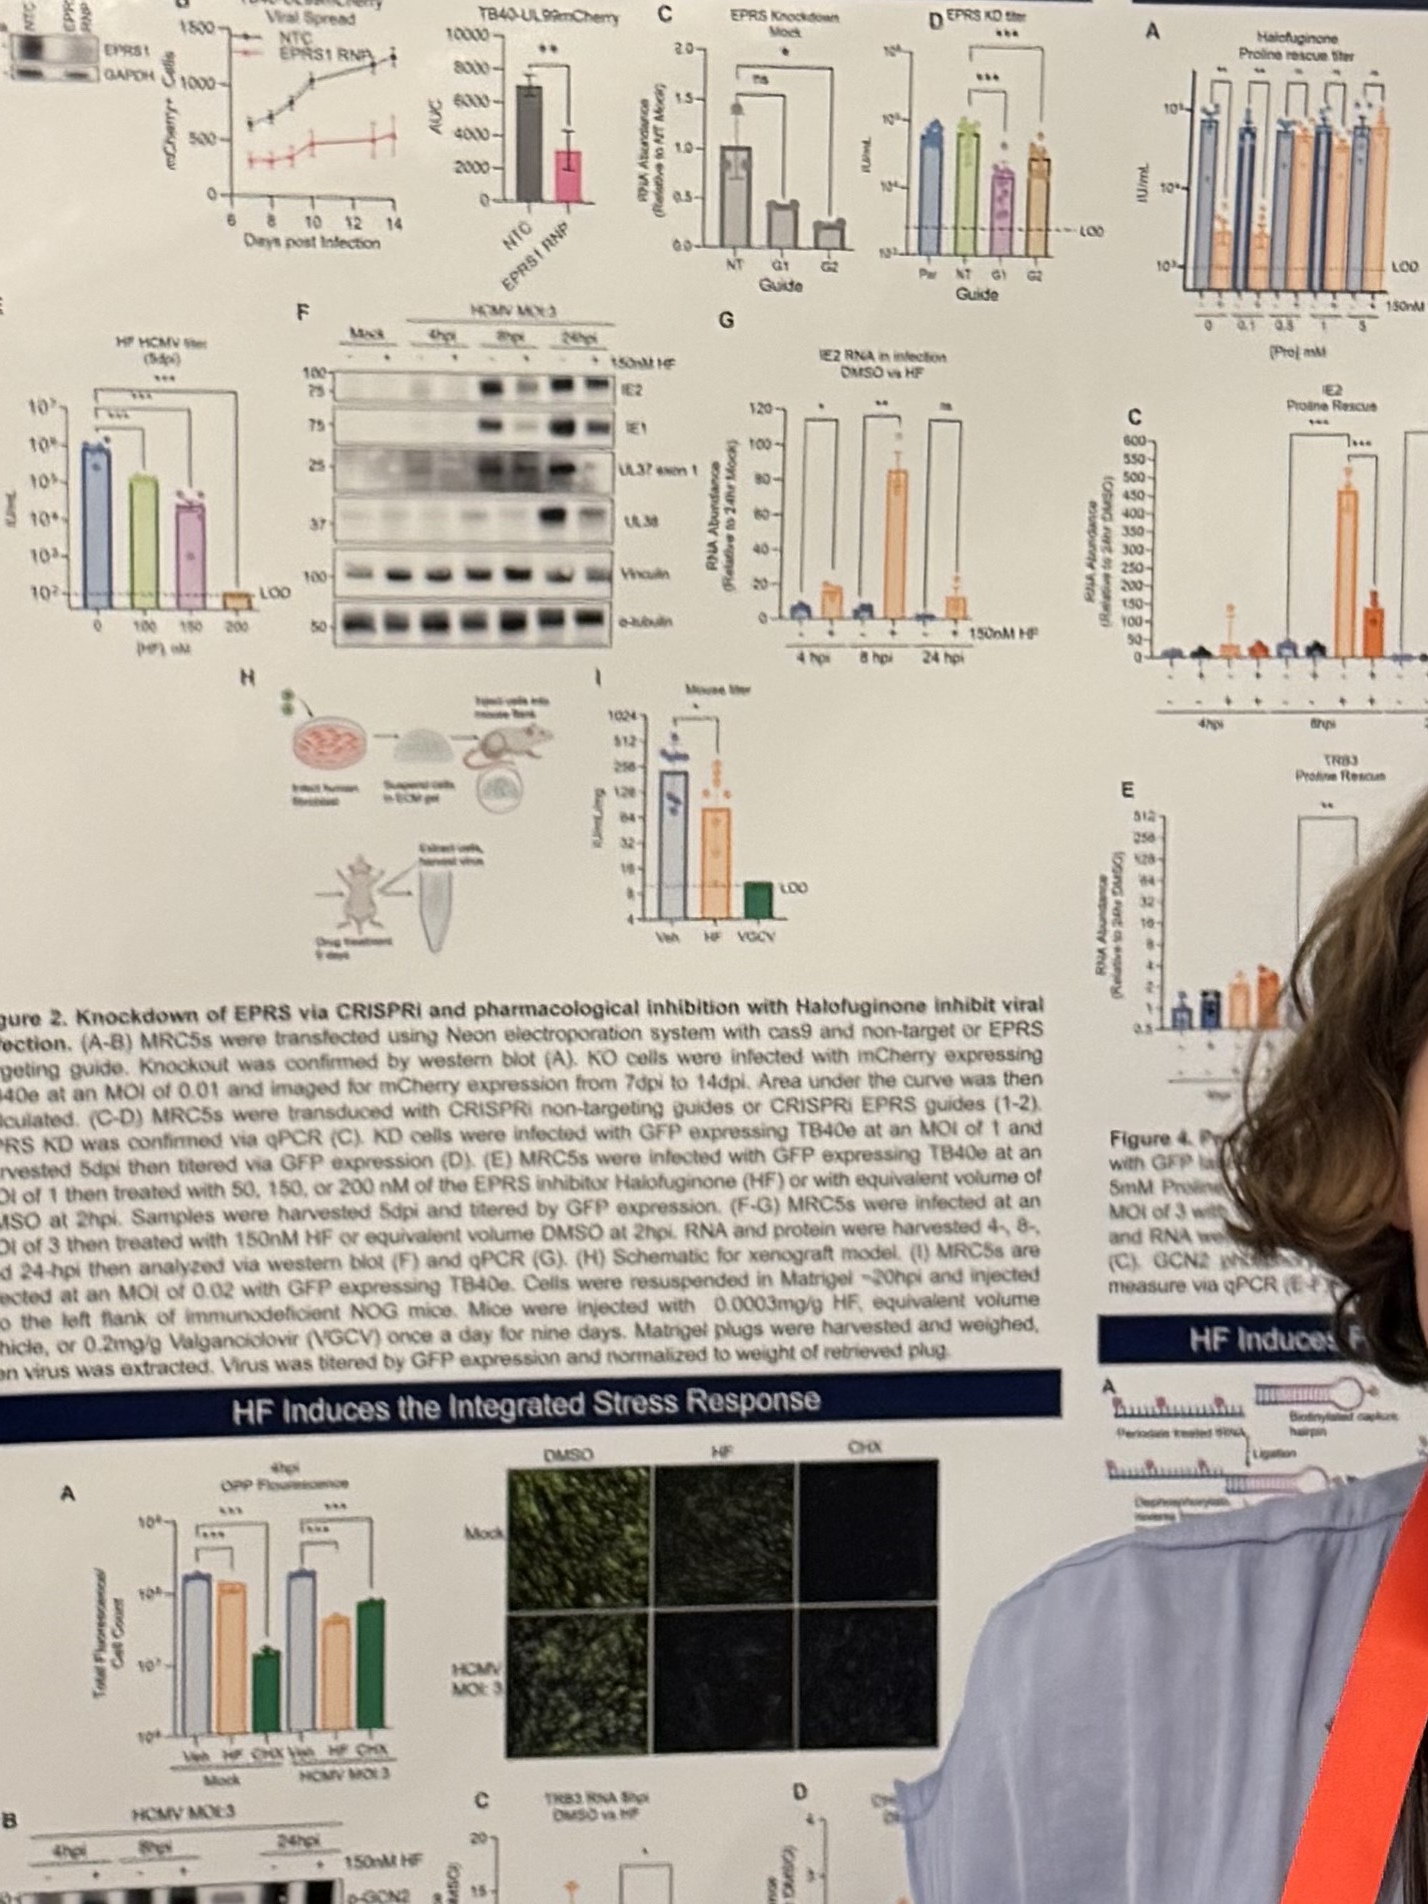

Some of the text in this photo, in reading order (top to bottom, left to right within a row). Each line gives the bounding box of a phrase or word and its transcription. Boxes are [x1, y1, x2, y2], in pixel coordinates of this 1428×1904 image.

[50, 1009, 68, 1027] 2.
[75, 1008, 200, 1026] Knockdown
[205, 1005, 227, 1023] of
[233, 1004, 292, 1023] EPRS
[298, 1003, 329, 1021] via
[335, 1001, 422, 1020] CRISPRi
[428, 1001, 466, 1019] and
[473, 999, 639, 1021] pharmacological
[646, 998, 740, 1016] inhibition
[746, 998, 788, 1015] with
[795, 997, 927, 1019] Halofuginone
[934, 996, 996, 1014] inhibit
[1001, 996, 1044, 1013] viral
[1110, 1130, 1192, 1149] Figure 4.
[1191, 1326, 1229, 1351] HF
[232, 1387, 821, 1425] HF Induces the Integrated Stress Response
